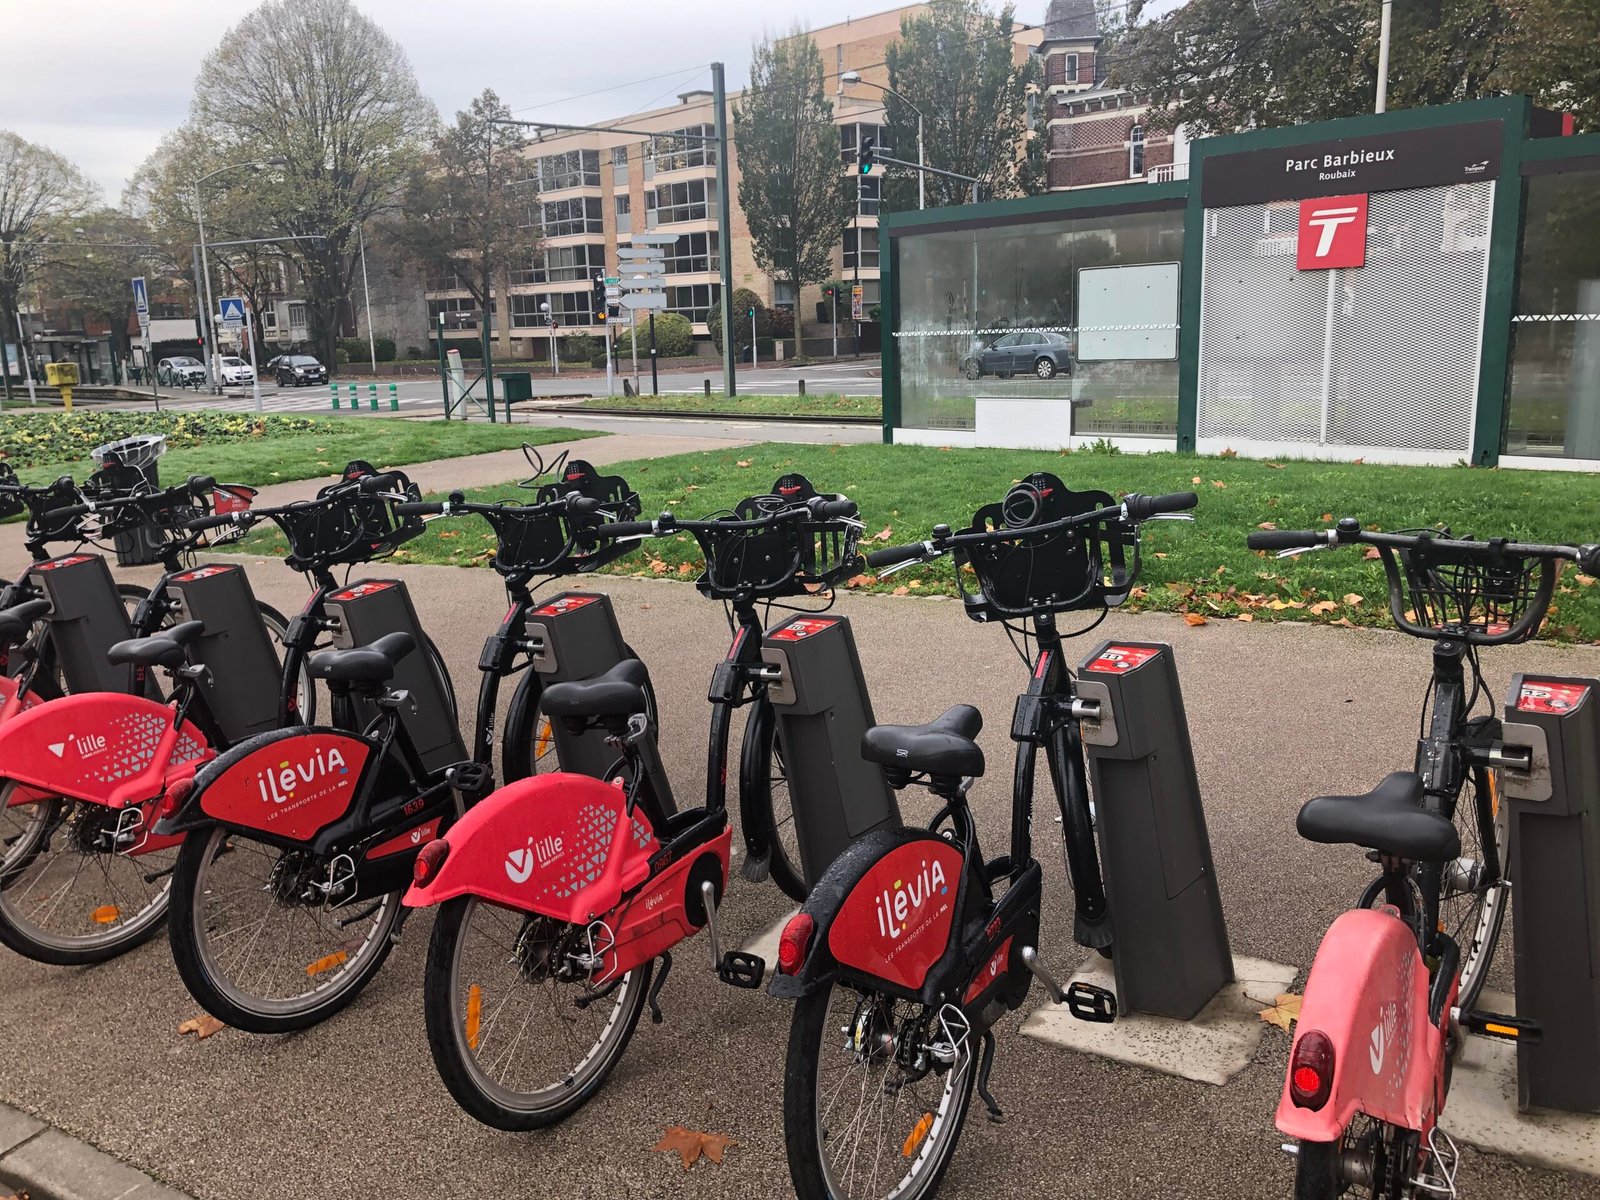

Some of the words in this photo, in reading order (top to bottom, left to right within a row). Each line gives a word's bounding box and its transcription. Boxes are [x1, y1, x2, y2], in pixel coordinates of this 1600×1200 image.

[1286, 158, 1318, 172] Parc
[1323, 149, 1395, 168] Barbieux
[1319, 169, 1356, 181] Roubaix
[1308, 206, 1359, 258] T
[404, 798, 425, 817] 1639
[895, 925, 926, 954] TRANSPORTS
